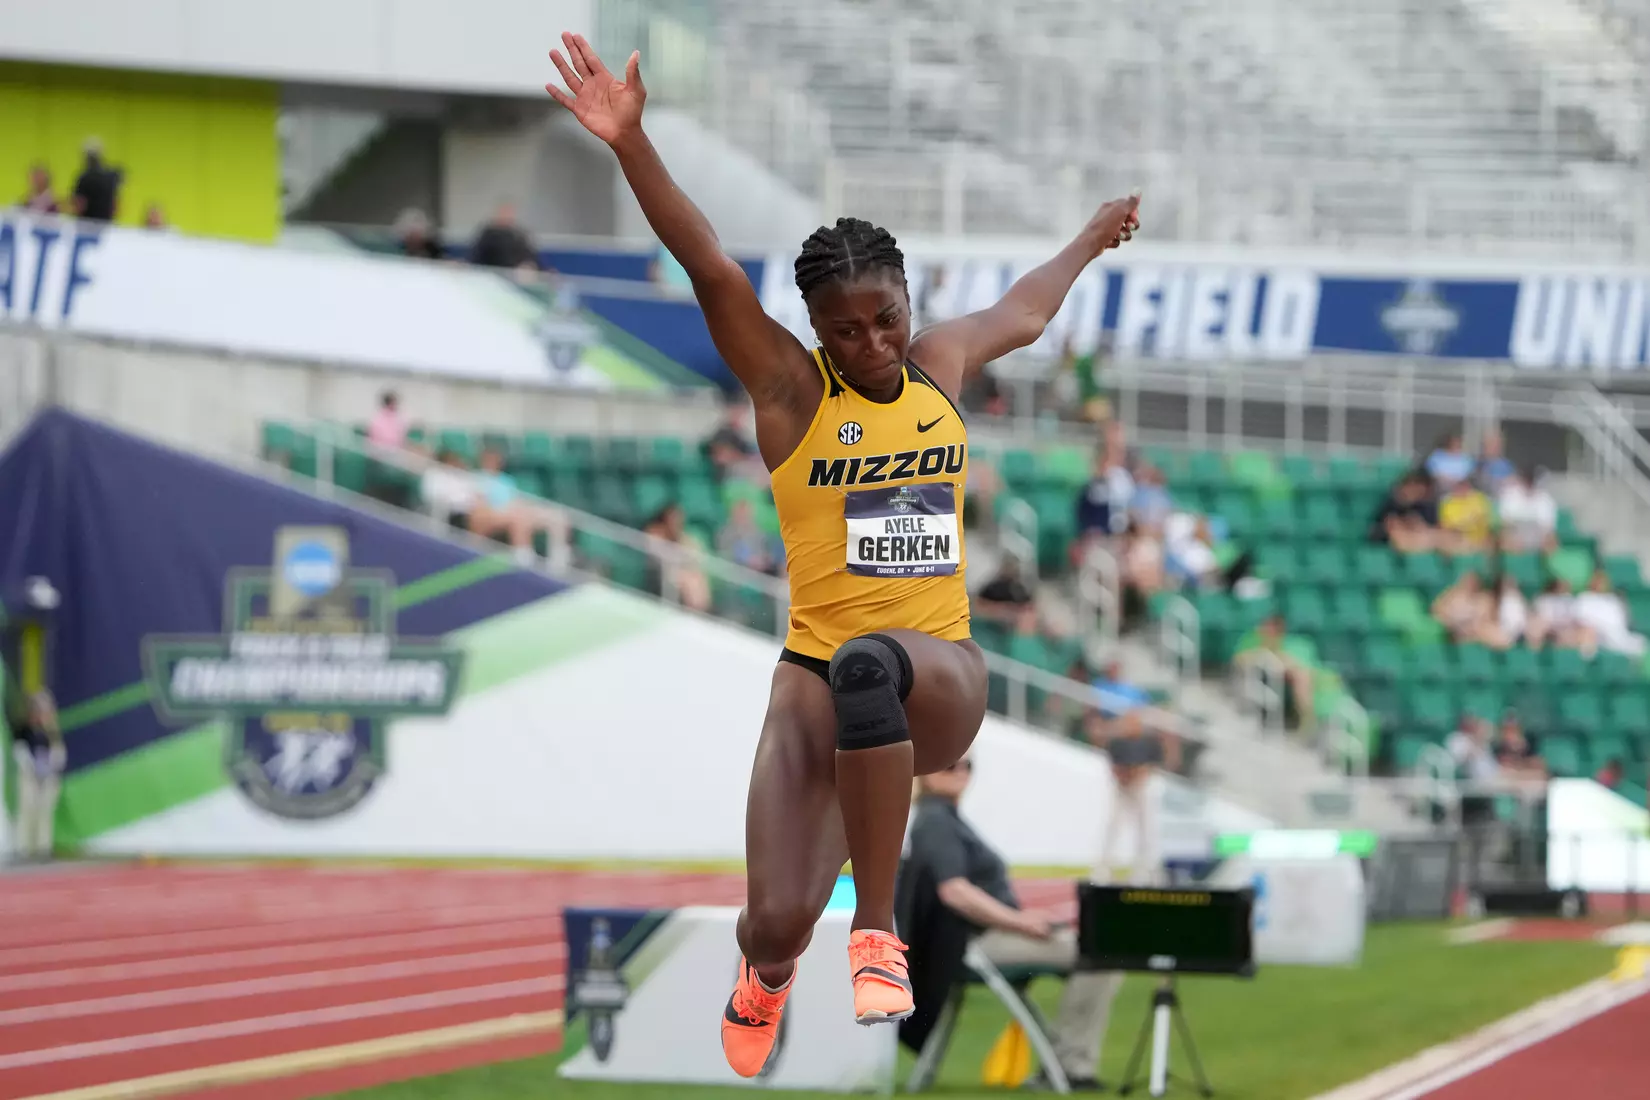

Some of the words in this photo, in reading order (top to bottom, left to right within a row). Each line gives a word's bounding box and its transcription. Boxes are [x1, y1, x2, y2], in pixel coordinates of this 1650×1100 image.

[1117, 264, 1318, 360] FIELD
[839, 422, 862, 444] SEC
[807, 443, 965, 487] MIZZOU
[884, 517, 926, 534] AYELE
[858, 534, 950, 562] GERKEN
